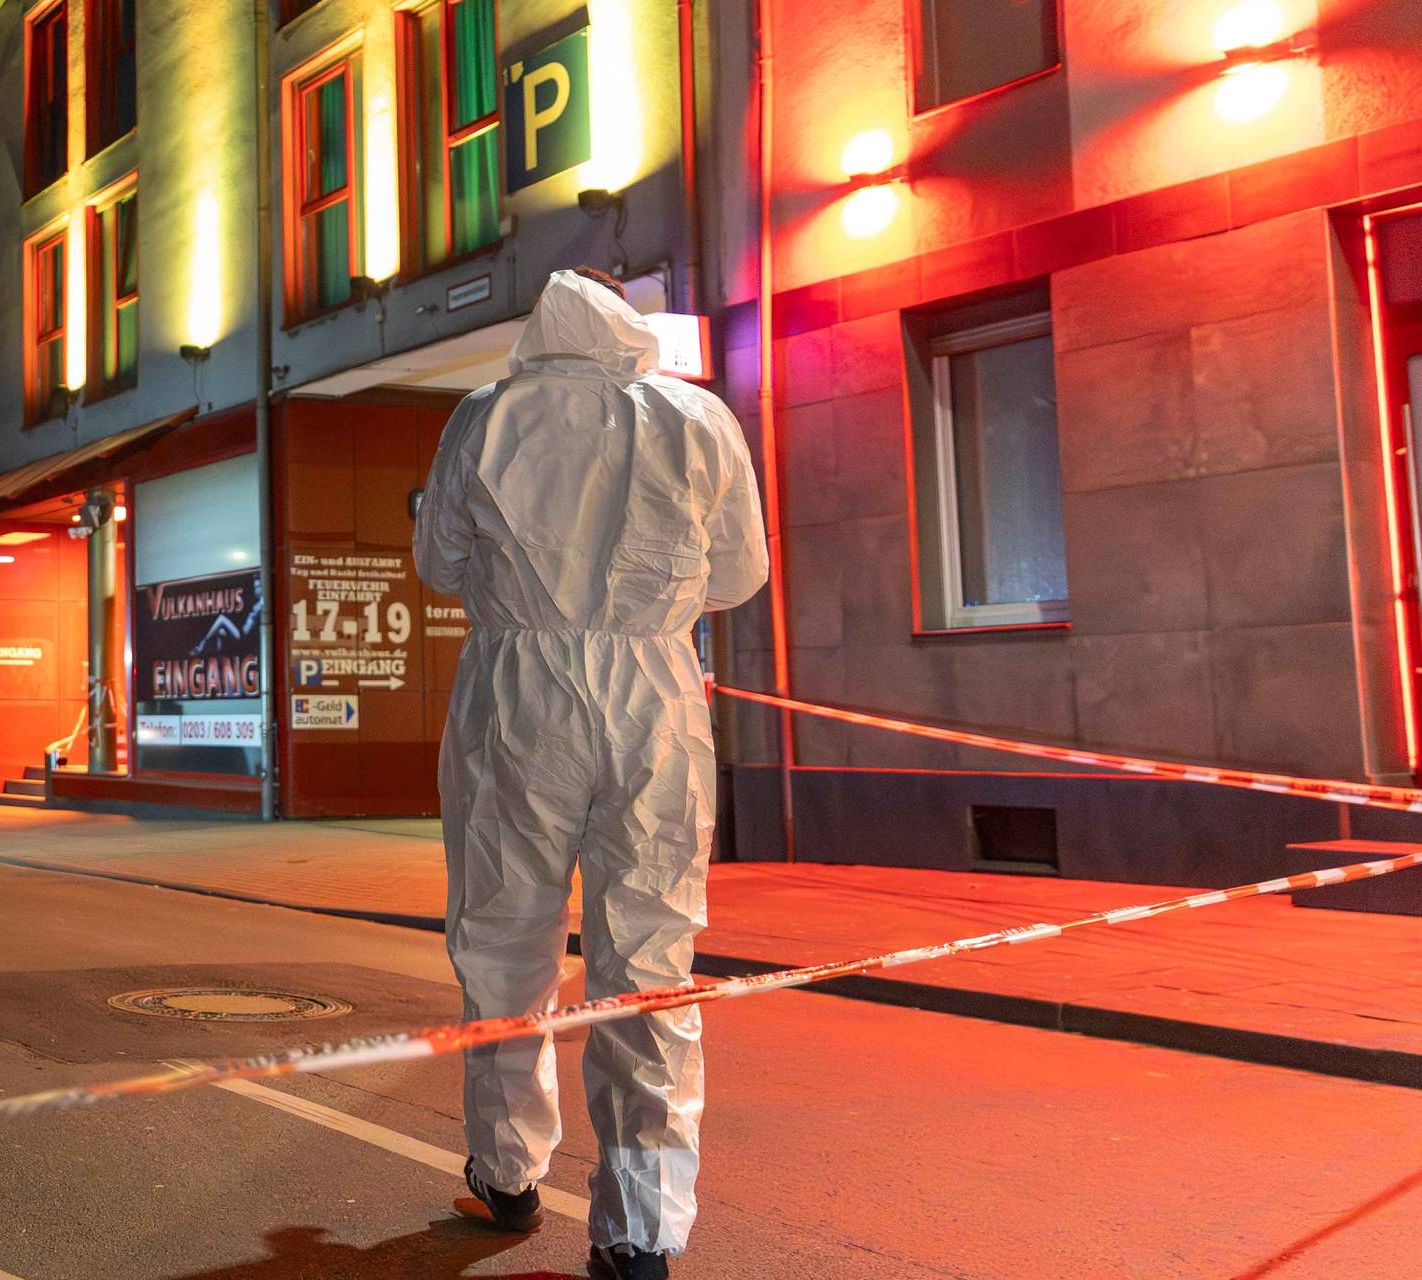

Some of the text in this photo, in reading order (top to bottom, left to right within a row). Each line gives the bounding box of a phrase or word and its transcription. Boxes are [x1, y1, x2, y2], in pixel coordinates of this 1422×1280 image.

[522, 61, 571, 171] P
[320, 557, 343, 565] und
[308, 579, 390, 592] FEUERWEHR
[317, 590, 382, 602] EINFAHRT
[146, 584, 245, 621] VULKANHAUS
[292, 599, 411, 644] 17-19
[152, 655, 260, 698] EINGANG
[300, 659, 406, 685] P EINGANG
[183, 721, 205, 738] 0203
[213, 721, 232, 739] 608
[235, 721, 254, 739] 309
[295, 715, 343, 725] automat
